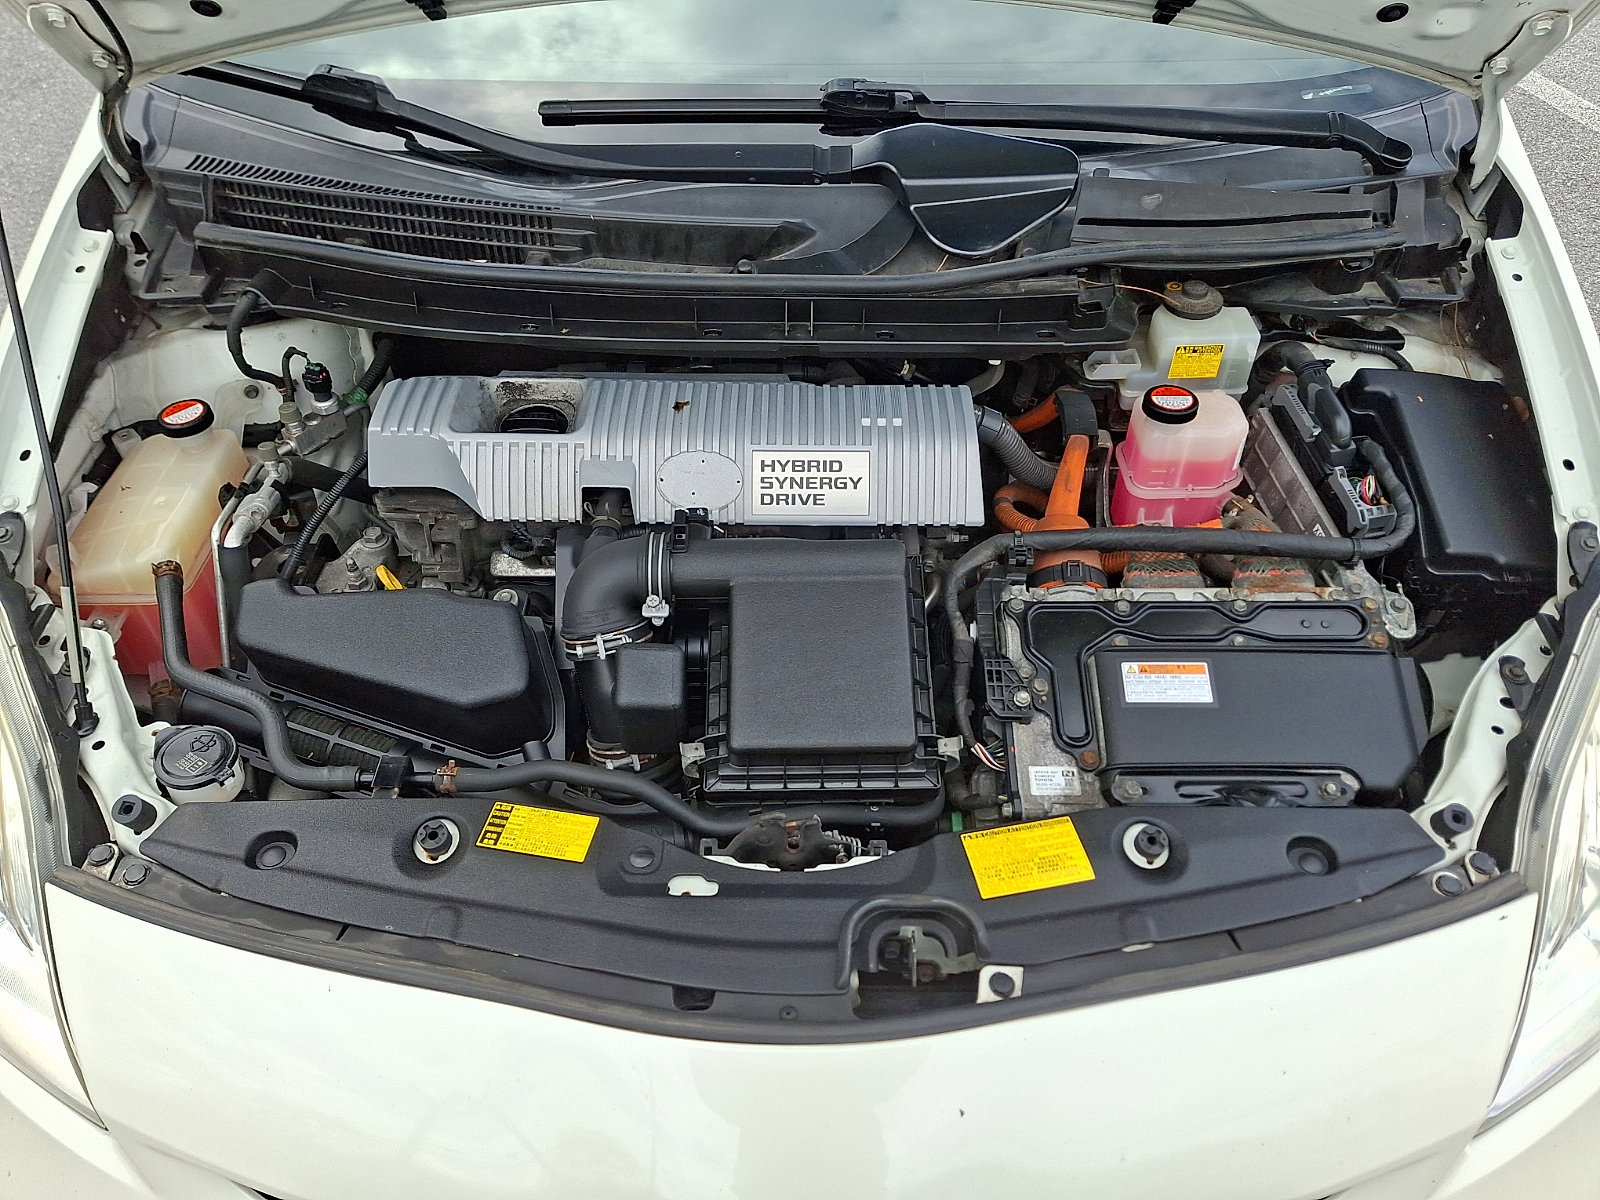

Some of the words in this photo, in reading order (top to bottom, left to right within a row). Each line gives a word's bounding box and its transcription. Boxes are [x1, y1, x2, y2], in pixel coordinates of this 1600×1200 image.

[760, 460, 843, 472] HYBRID
[760, 477, 863, 489] SYNERGY
[760, 494, 825, 505] DRIVE
